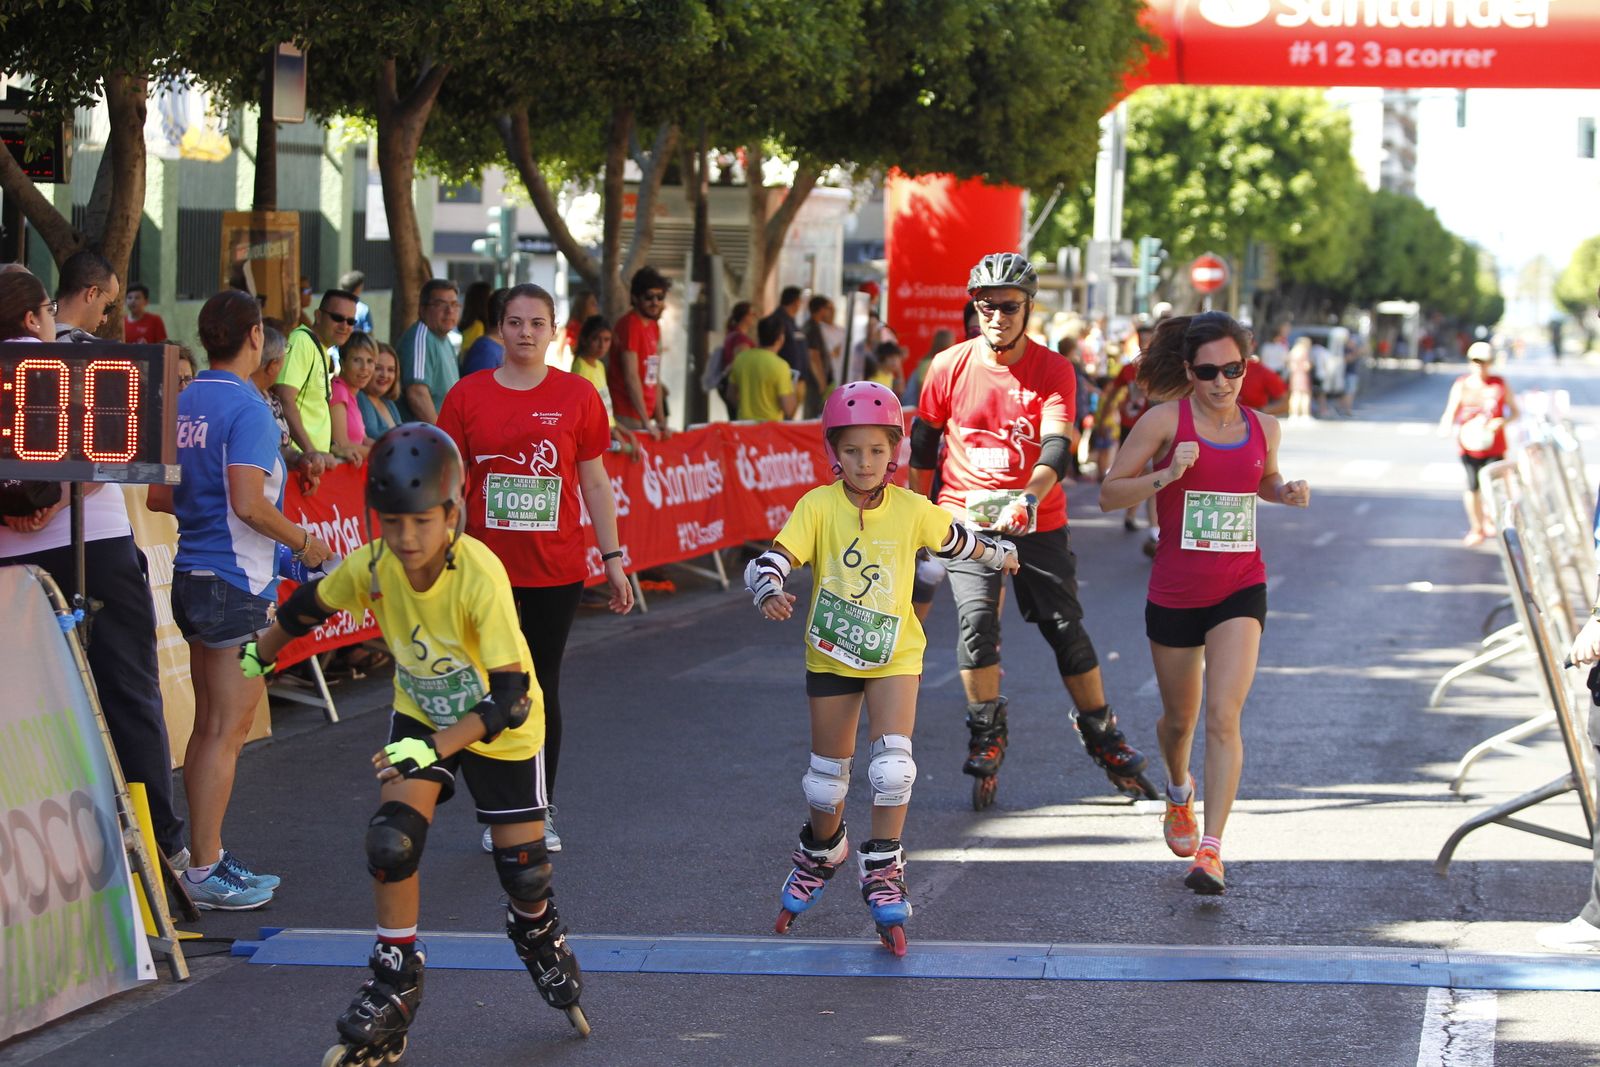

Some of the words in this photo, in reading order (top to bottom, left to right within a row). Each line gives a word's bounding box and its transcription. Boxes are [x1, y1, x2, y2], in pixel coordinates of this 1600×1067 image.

[494, 491, 547, 511] 1096
[507, 511, 519, 519] ANA
[1193, 509, 1246, 530] 1122
[1221, 532, 1231, 540] DEL
[823, 611, 881, 650] 1289
[836, 637, 861, 656] DANIELA
